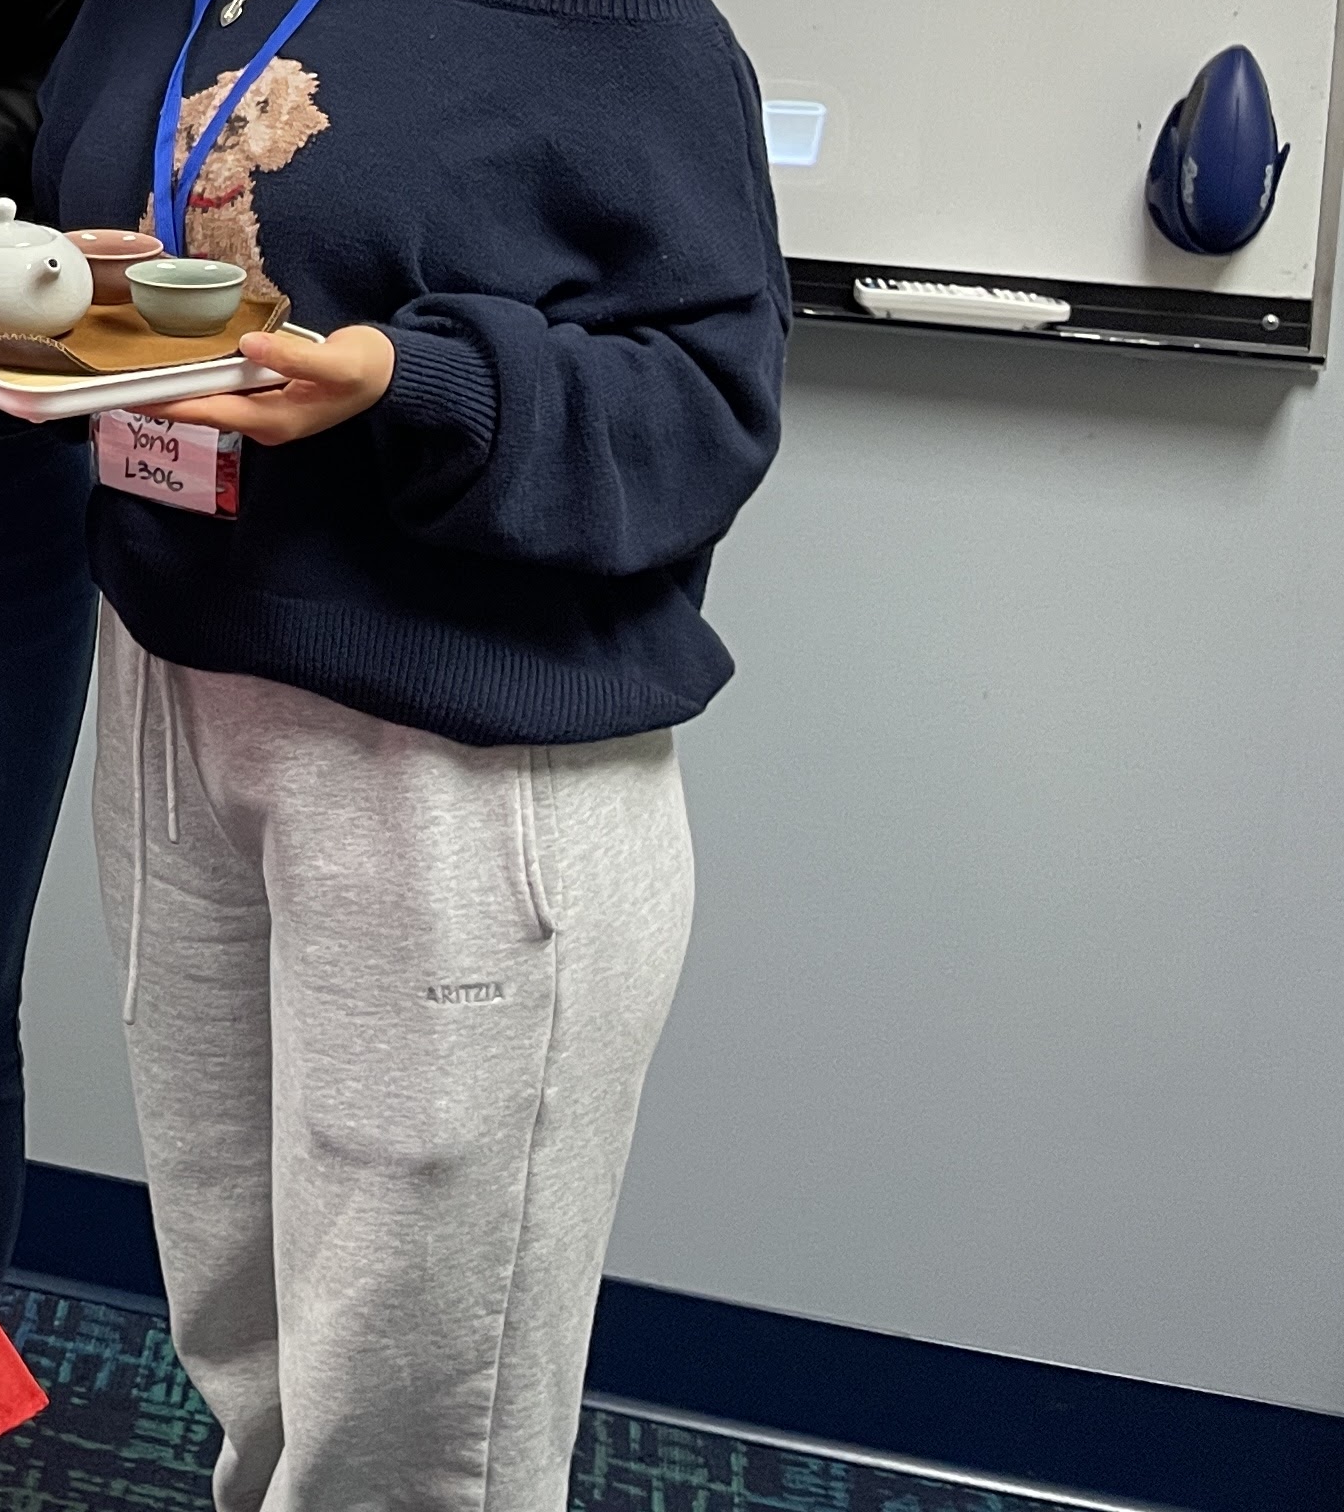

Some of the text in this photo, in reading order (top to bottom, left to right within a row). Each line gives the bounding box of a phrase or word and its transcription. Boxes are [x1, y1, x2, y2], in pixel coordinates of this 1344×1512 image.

[127, 422, 179, 461] Yong
[124, 457, 184, 492] L306
[426, 981, 506, 1004] ARITZIA
